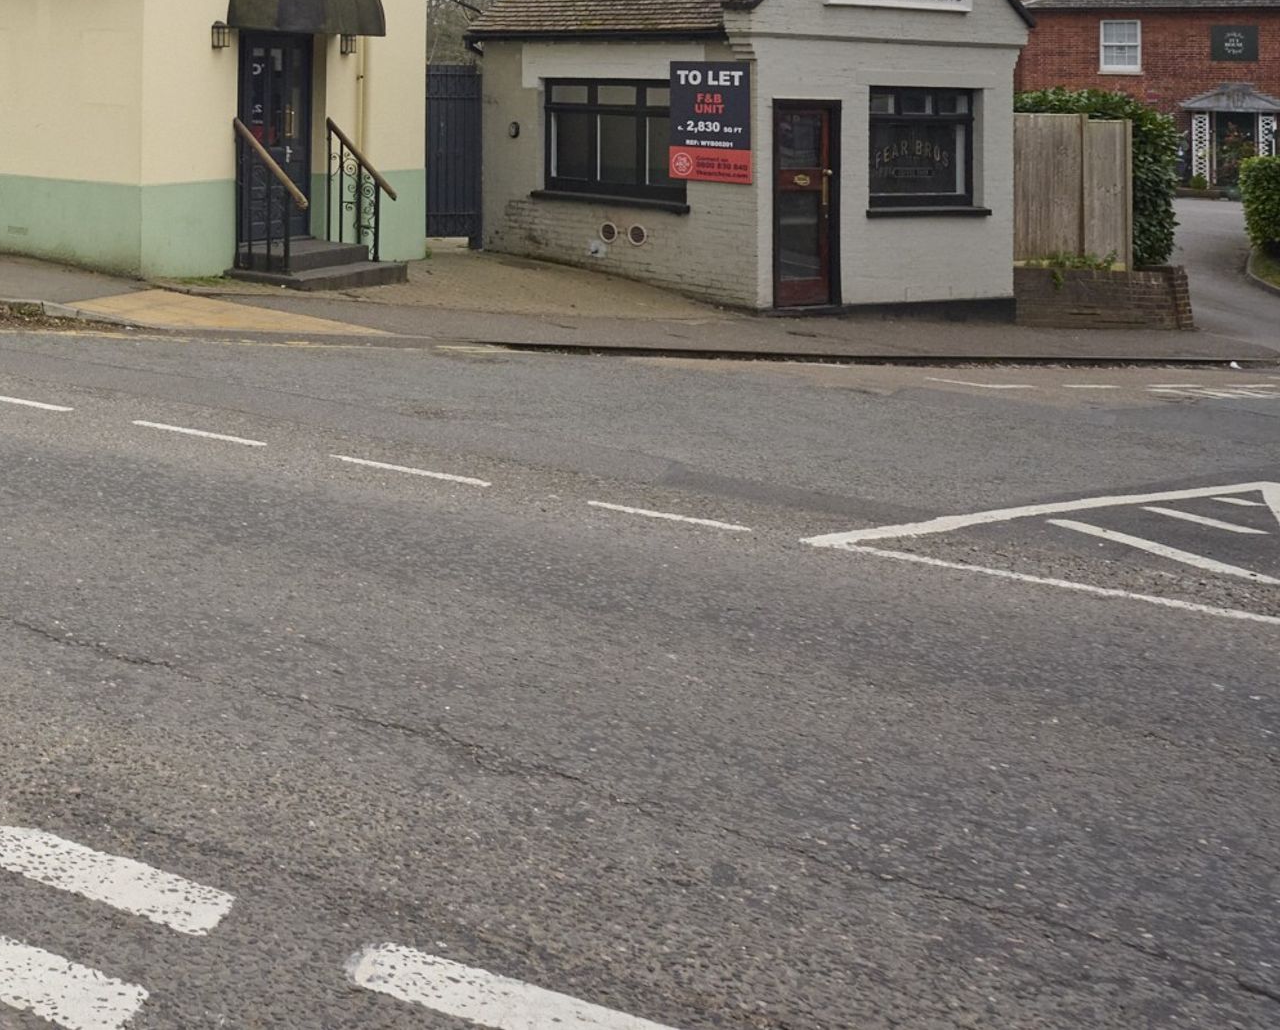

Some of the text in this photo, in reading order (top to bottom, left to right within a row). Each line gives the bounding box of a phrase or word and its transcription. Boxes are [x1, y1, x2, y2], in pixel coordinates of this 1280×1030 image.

[677, 70, 744, 86] TO LET
[696, 93, 722, 103] F&B
[694, 104, 725, 115] UNIT
[686, 120, 721, 133] 2,830
[875, 139, 950, 170] FEAR BROS
